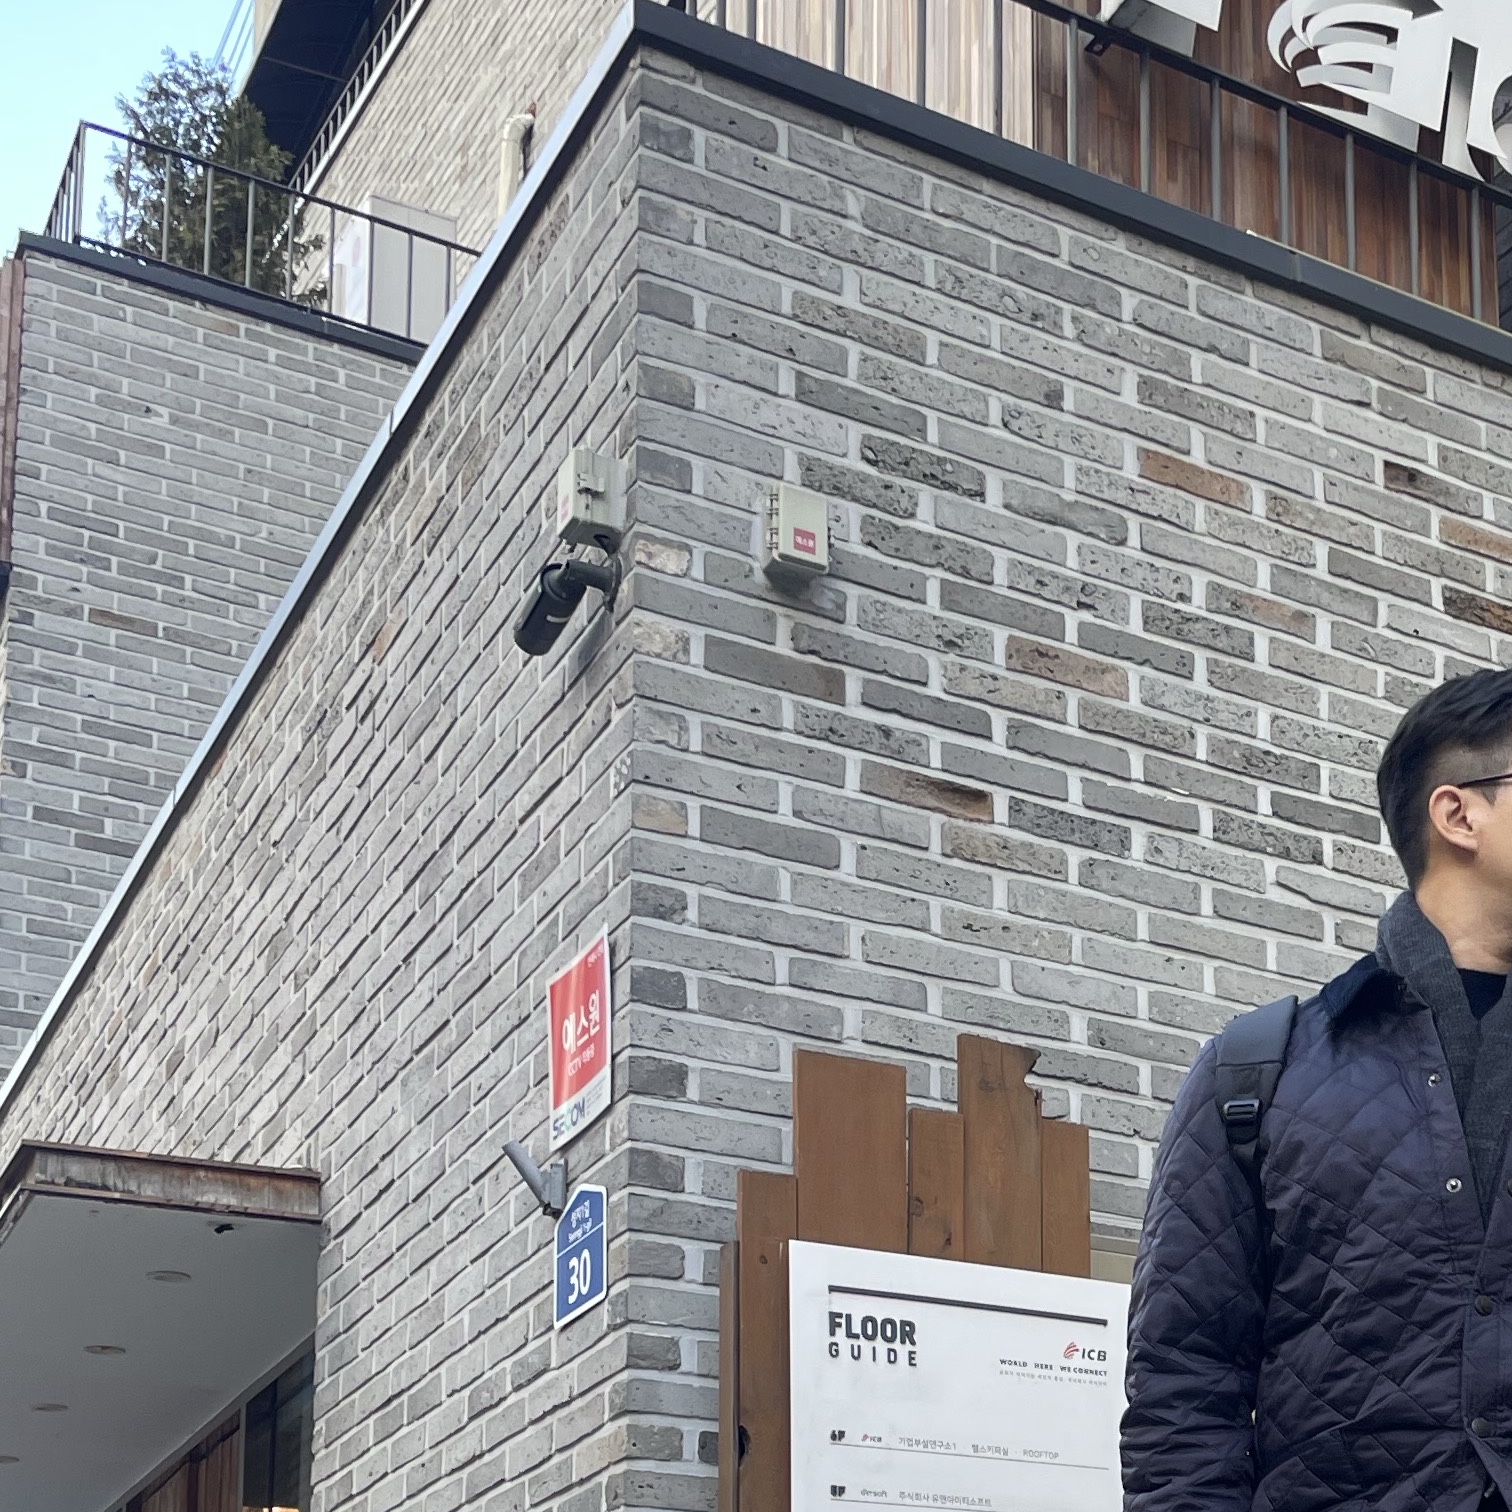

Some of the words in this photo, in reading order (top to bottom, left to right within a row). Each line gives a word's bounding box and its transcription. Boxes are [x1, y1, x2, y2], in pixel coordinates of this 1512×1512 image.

[562, 989, 600, 1054] 에스원
[553, 1097, 585, 1141] SECOM
[568, 1248, 591, 1304] 30
[828, 1311, 916, 1346] FLOOR
[828, 1342, 917, 1367] GUIDE
[1081, 1348, 1107, 1361] ICB
[1073, 1368, 1108, 1377] CONNECT
[1023, 1449, 1059, 1460] ROOFTOP
[898, 1491, 929, 1502] 주식회사
